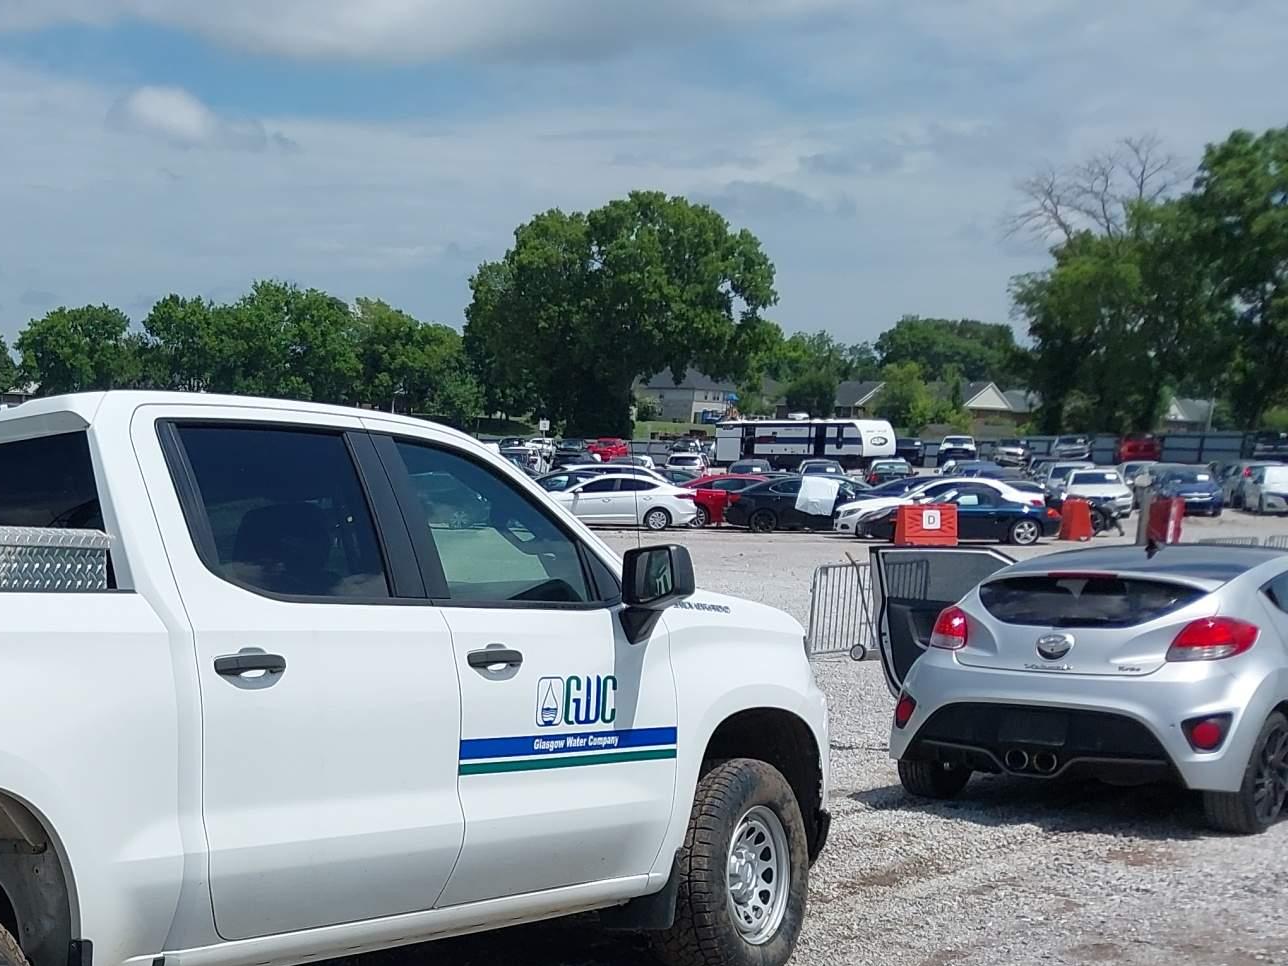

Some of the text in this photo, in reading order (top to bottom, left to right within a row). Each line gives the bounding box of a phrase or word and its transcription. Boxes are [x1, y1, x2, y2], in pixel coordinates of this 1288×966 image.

[927, 515, 936, 525] D
[564, 674, 618, 726] GWC
[533, 735, 620, 752] Glasgow Water Company
